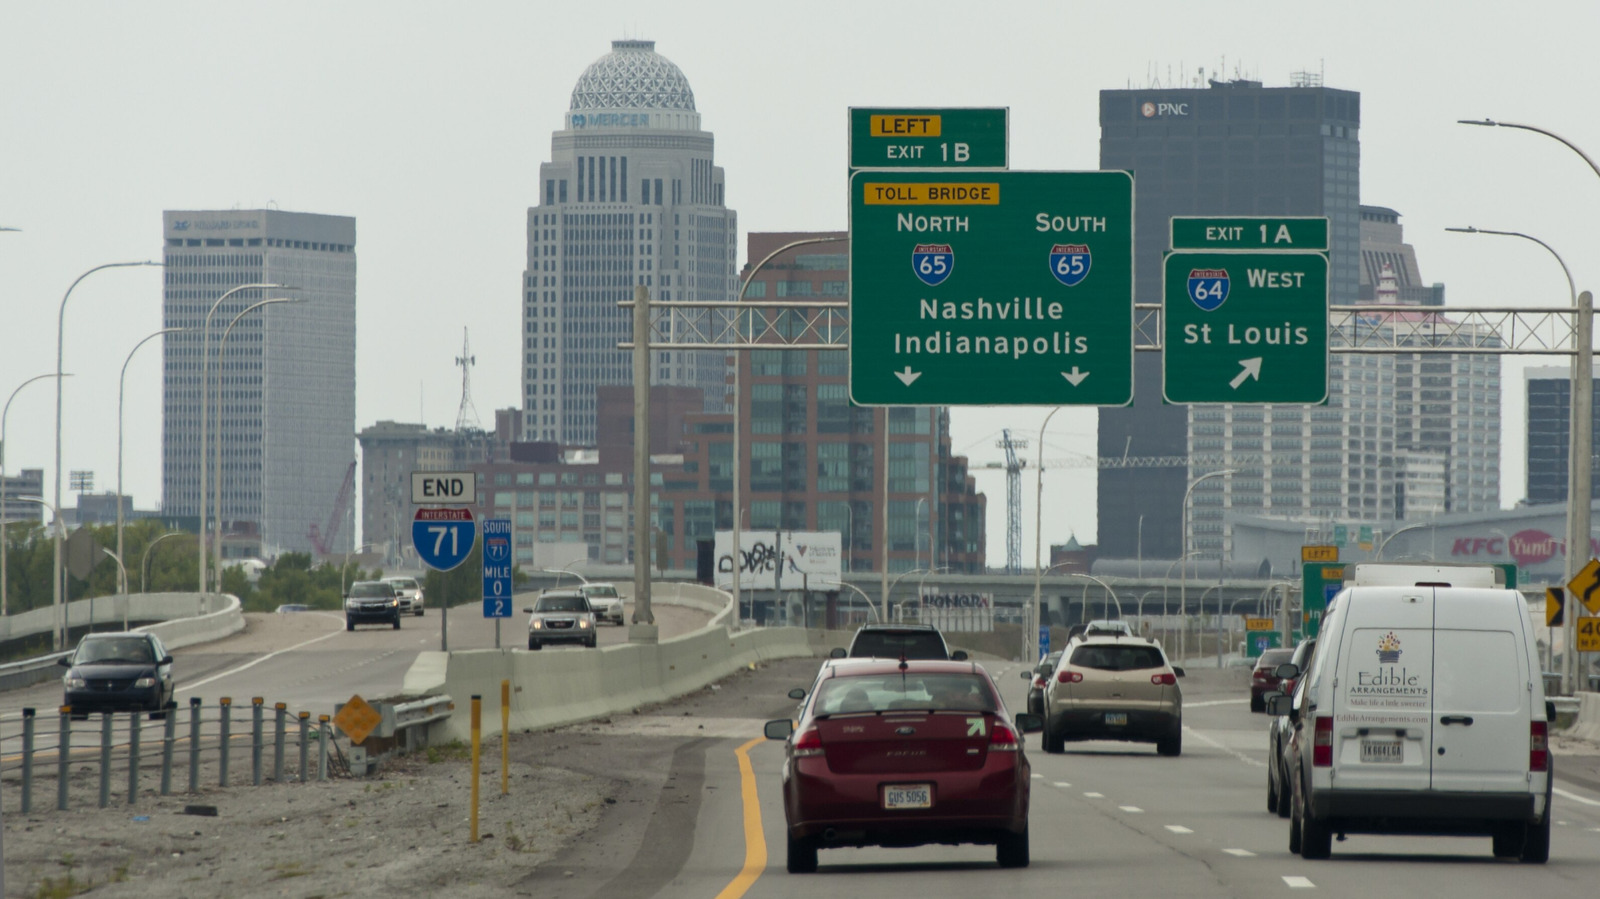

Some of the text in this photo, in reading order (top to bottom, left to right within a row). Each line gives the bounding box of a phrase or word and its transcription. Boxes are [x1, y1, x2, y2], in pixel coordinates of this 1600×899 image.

[1158, 103, 1188, 115] PNC
[588, 113, 649, 127] MERCER
[881, 118, 930, 133] LEFT
[887, 143, 970, 162] EXIT 1B
[875, 187, 991, 200] TOLL BRIDGE
[897, 213, 969, 232] NORTH
[1035, 213, 1106, 232] SOUTH
[1206, 224, 1293, 243] EXIT 1A
[920, 256, 947, 275] 65
[1057, 256, 1084, 275] 65
[1247, 269, 1305, 288] WEST
[1195, 280, 1223, 300] 64
[920, 297, 1063, 319] Nashville
[1184, 322, 1309, 345] St Louis
[895, 331, 1088, 359] Indianapolis
[423, 479, 464, 497] END
[421, 511, 466, 520] INTERSTATE
[484, 522, 511, 534] SOUTH
[427, 526, 459, 557] 71
[1452, 538, 1503, 556] KFC
[1513, 538, 1553, 556] Yum!
[491, 546, 503, 557] 71
[1308, 550, 1331, 558] LEFT
[485, 567, 510, 578] MILE
[493, 581, 502, 595] 0
[1359, 667, 1417, 686] Edible
[1350, 687, 1428, 695] ARRANGEMENTS
[1336, 714, 1428, 724] EdibleArrangements.com
[888, 791, 927, 803] GUS 5056
